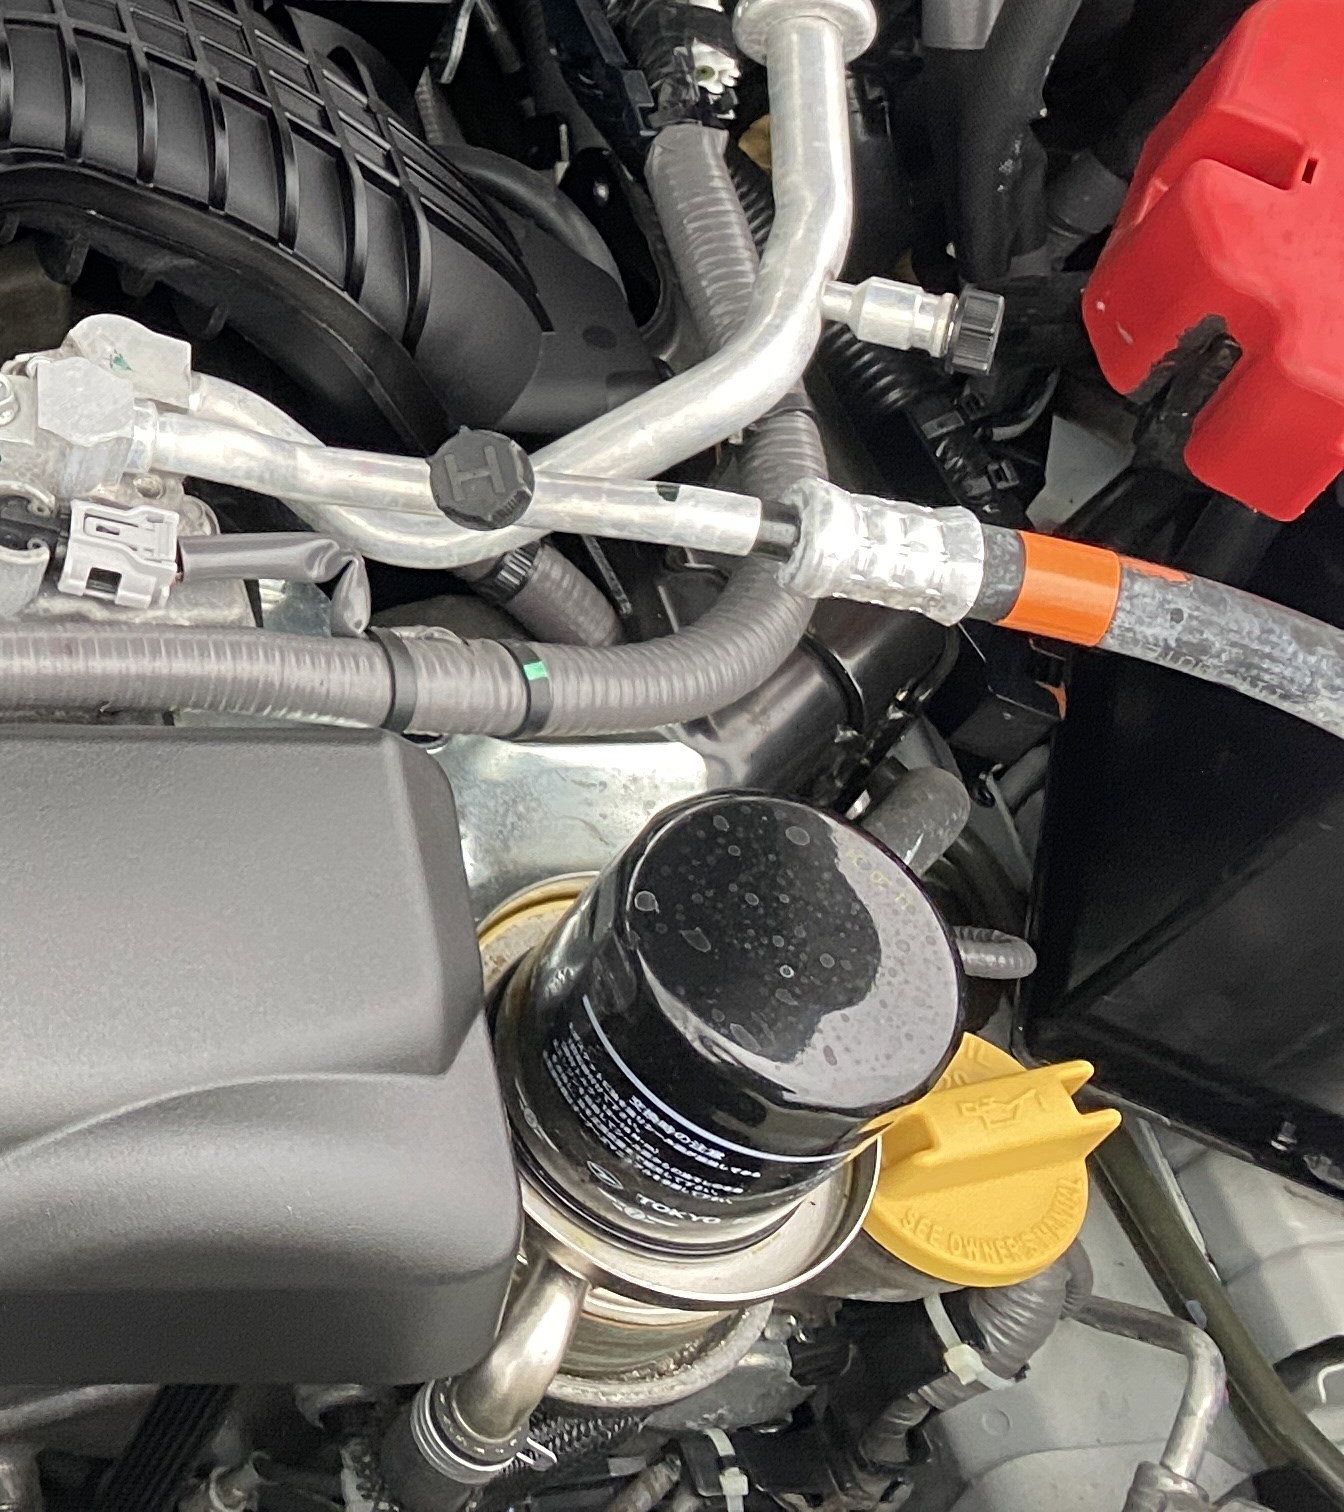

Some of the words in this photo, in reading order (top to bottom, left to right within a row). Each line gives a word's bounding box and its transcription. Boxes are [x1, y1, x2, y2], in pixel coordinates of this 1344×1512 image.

[444, 445, 506, 502] H
[637, 1193, 721, 1224] TOKYO
[900, 1207, 944, 1247] SEE
